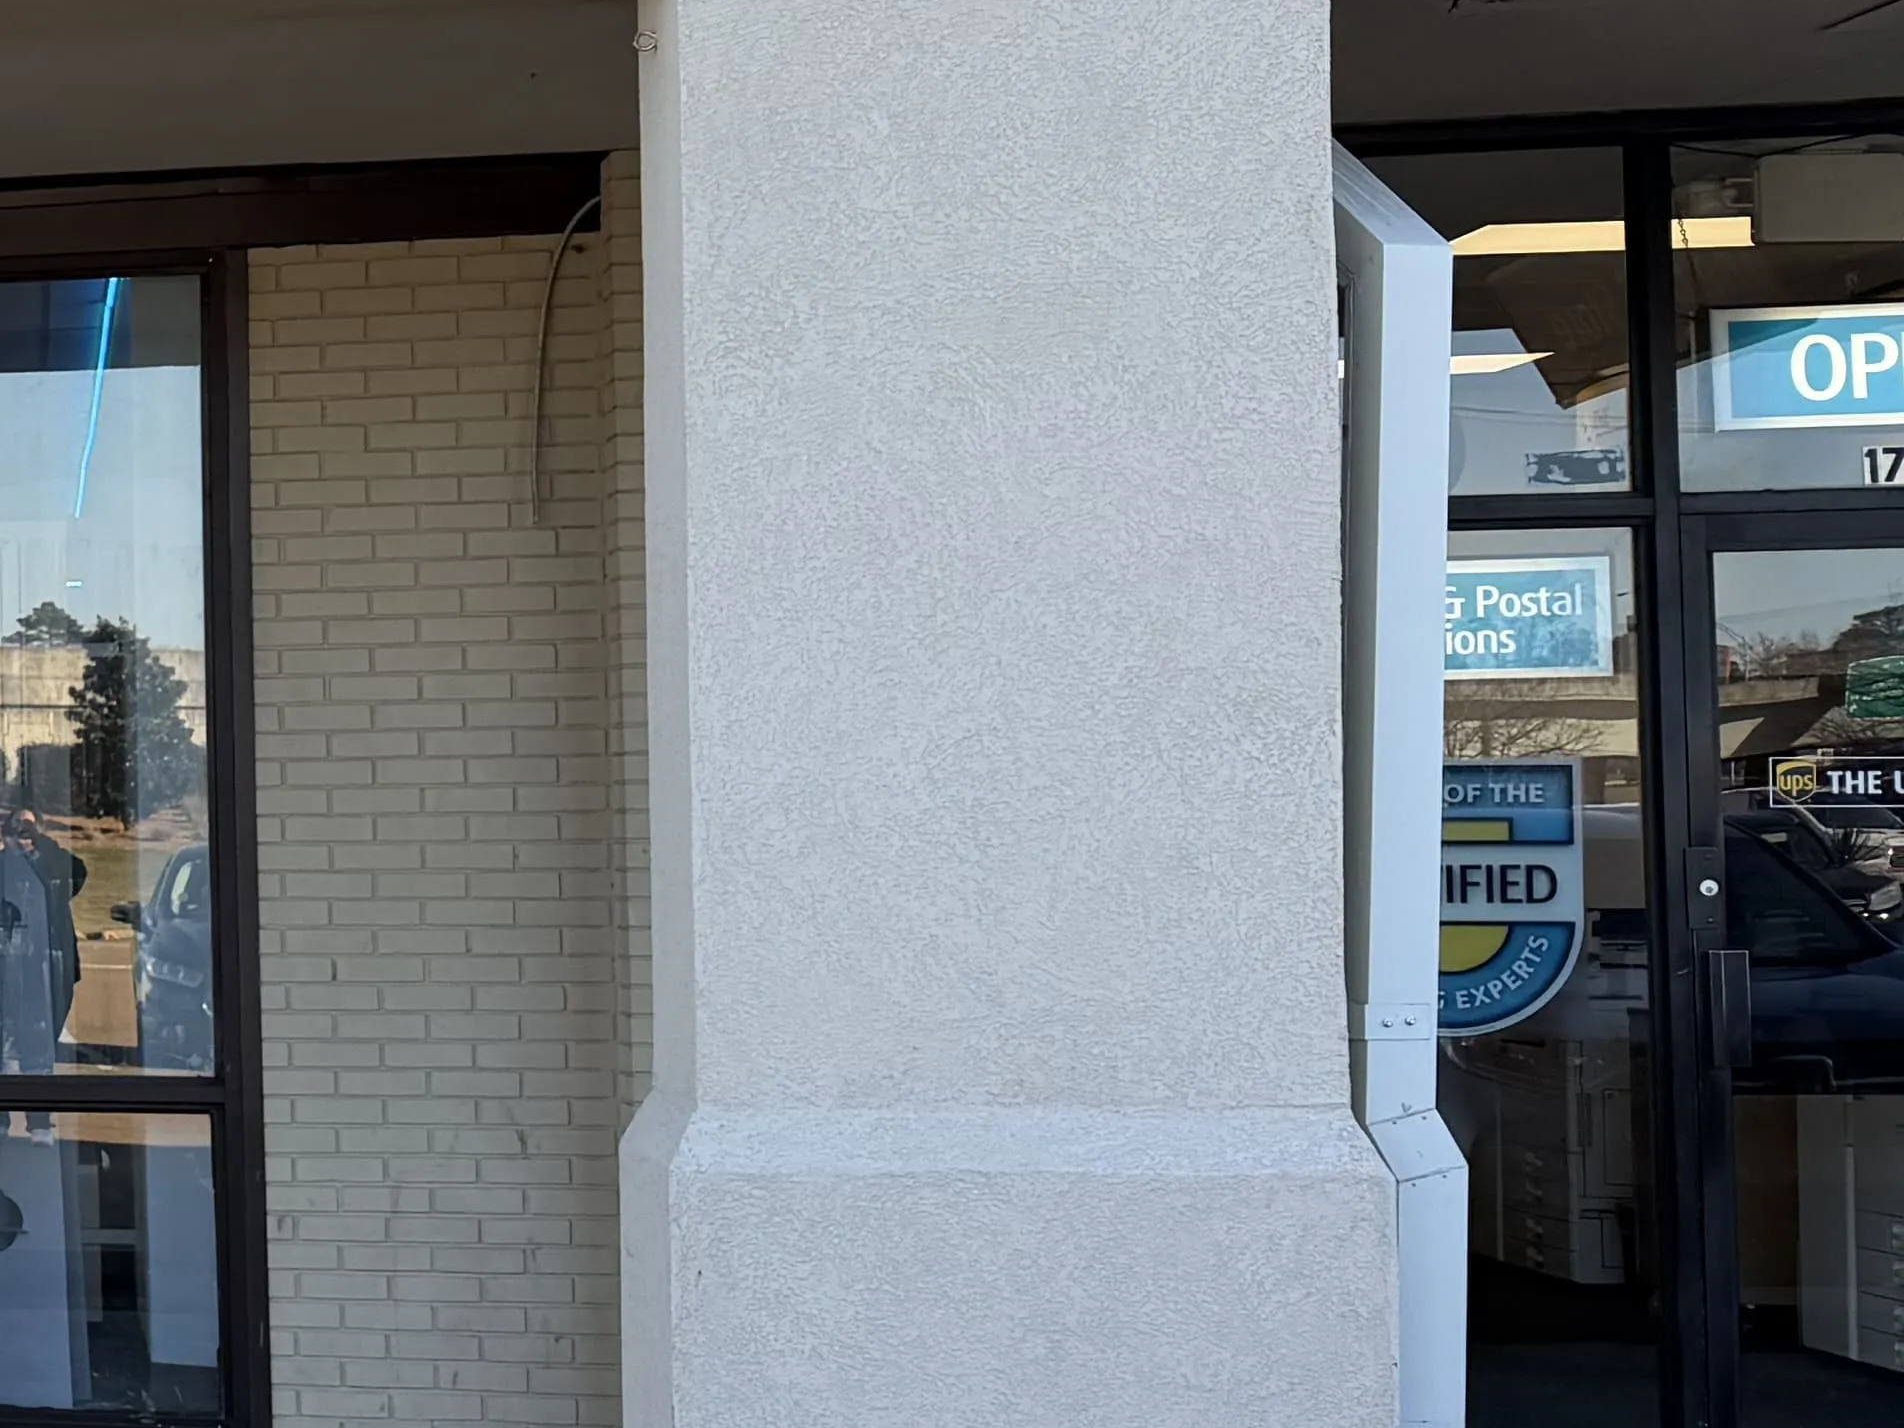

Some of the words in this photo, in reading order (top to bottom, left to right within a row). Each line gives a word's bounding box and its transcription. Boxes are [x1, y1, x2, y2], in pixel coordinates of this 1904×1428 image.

[1789, 331, 1904, 403] OP
[1476, 582, 1583, 619] Postal
[1444, 622, 1518, 655] ions
[1444, 782, 1482, 804] OF
[1489, 782, 1545, 804] THE
[1780, 774, 1813, 797] ups
[1826, 770, 1883, 795] THE
[1442, 862, 1559, 905] IFIED
[1455, 934, 1550, 1010] EXPERTS
